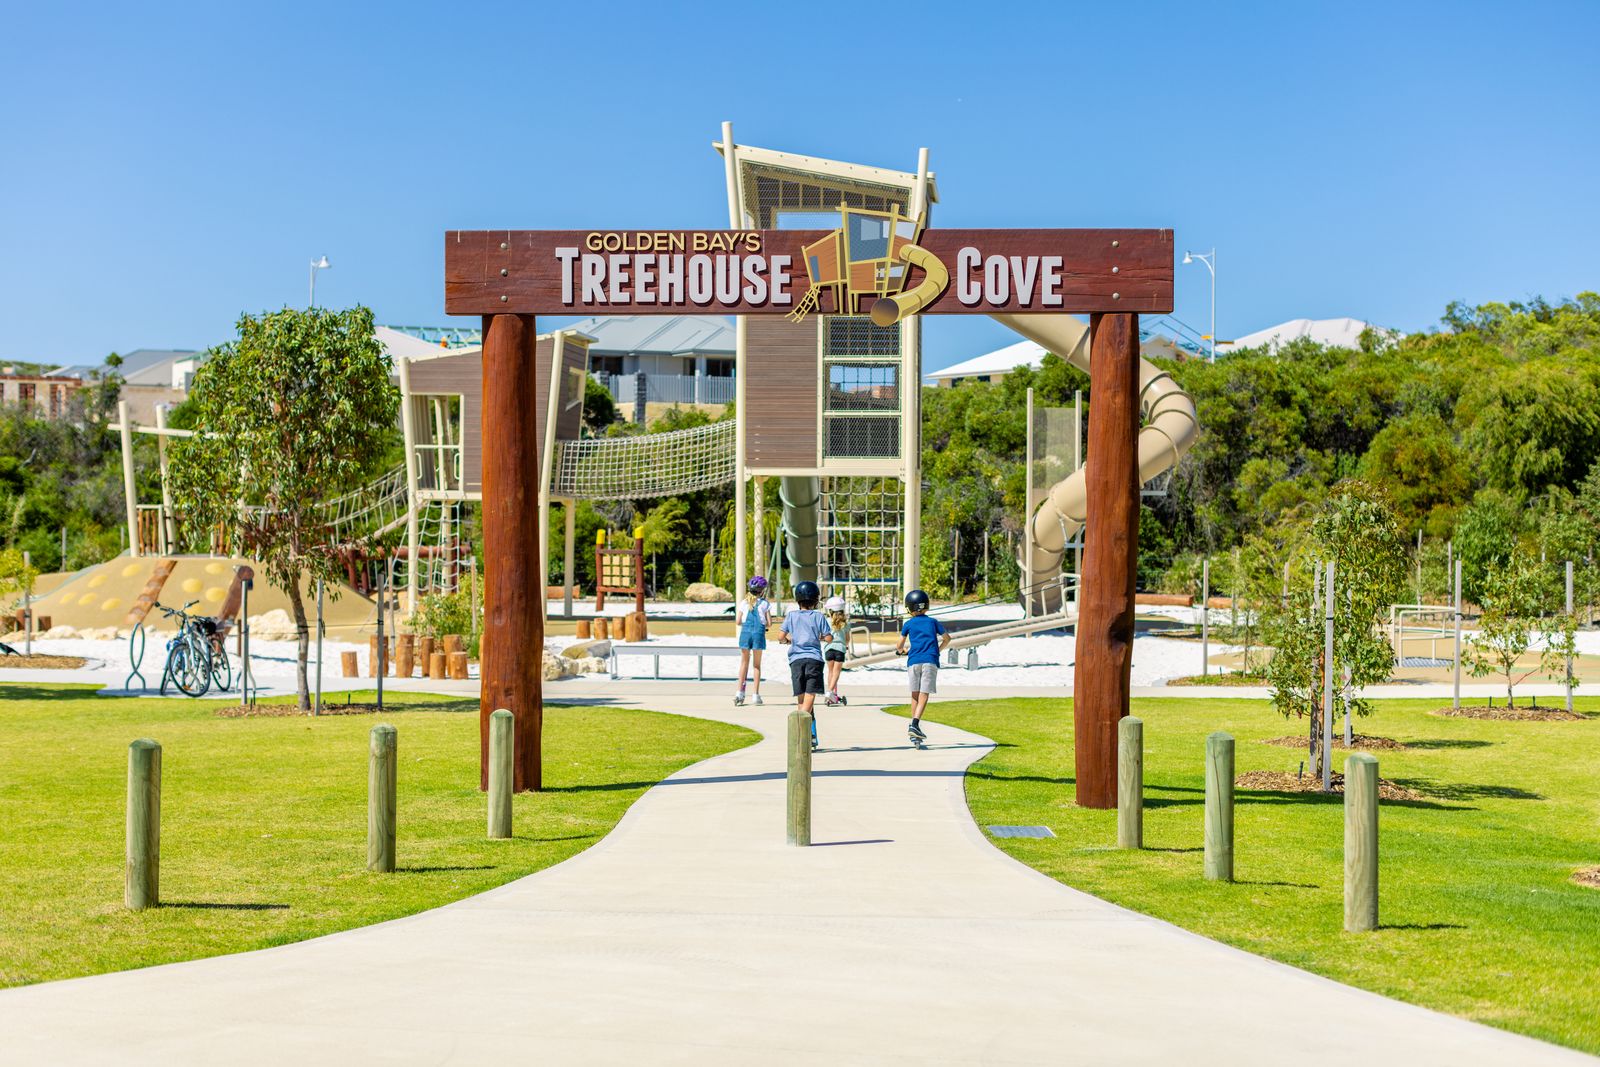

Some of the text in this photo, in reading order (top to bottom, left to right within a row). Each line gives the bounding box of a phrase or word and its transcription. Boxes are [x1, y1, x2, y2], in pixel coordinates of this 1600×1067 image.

[586, 232, 761, 252] GOLDEN BAY'S
[555, 246, 1063, 305] TREEHOUSE COVE
